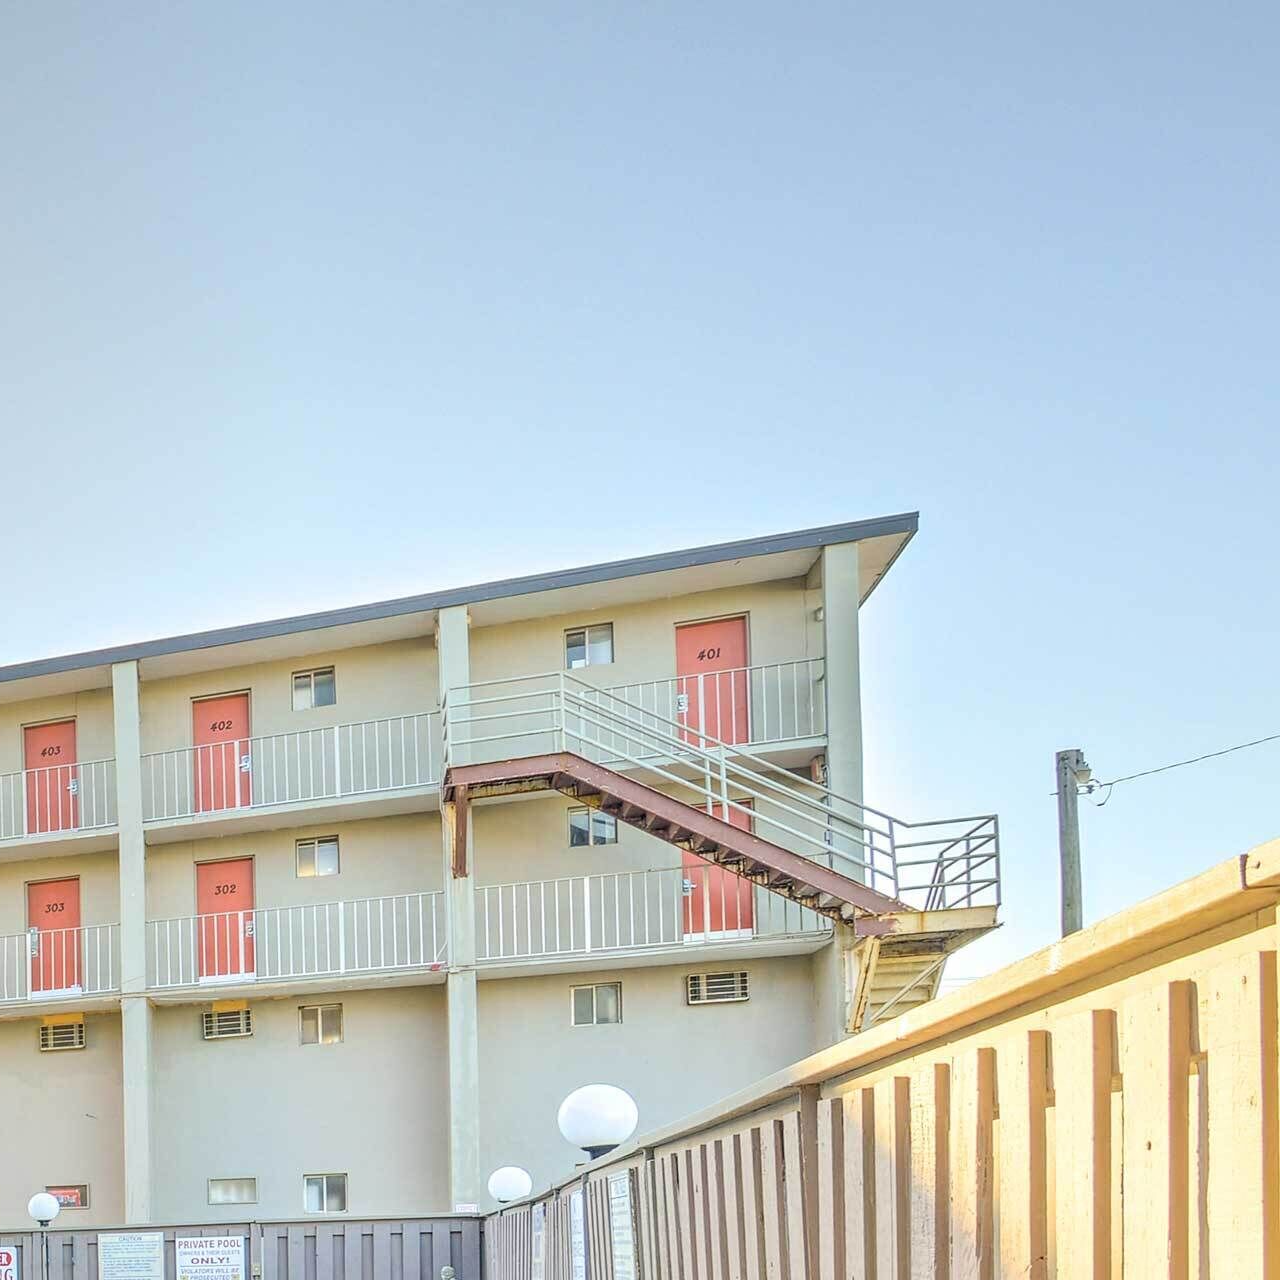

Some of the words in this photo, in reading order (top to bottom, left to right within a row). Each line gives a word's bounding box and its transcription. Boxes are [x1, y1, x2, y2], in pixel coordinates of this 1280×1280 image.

[697, 648, 721, 661] 401
[210, 720, 233, 732] 402
[41, 746, 61, 757] 403
[215, 884, 237, 895] 302
[45, 902, 65, 913] 303
[178, 1240, 215, 1248] PRIVATE
[217, 1239, 241, 1248] POOL
